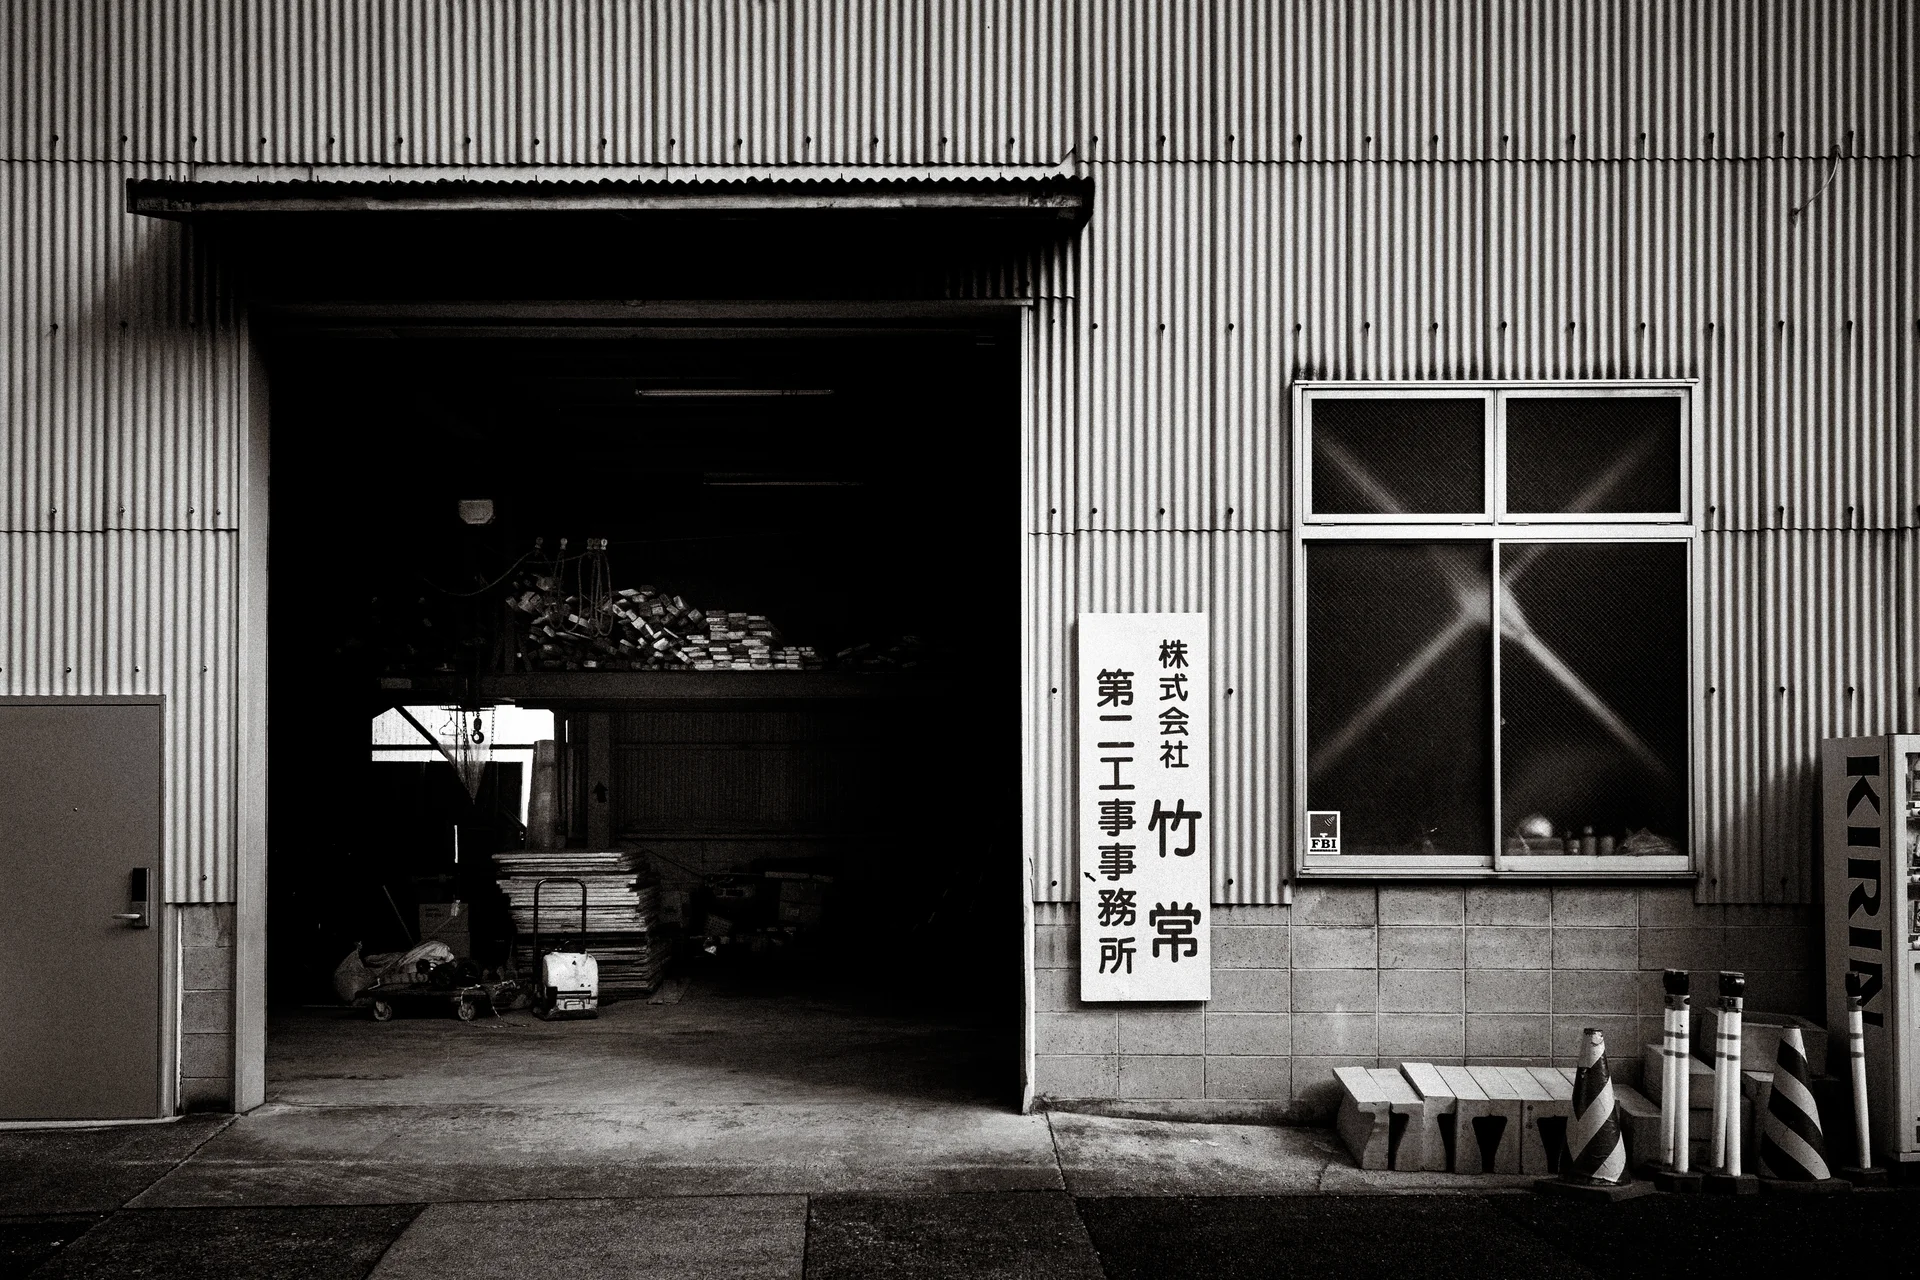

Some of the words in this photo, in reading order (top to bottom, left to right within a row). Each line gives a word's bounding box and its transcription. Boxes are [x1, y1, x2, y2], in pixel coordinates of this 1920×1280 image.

[1158, 639, 1190, 769] 株式会社
[1096, 668, 1137, 975] 第二工事事務所
[1311, 838, 1336, 848] FBI
